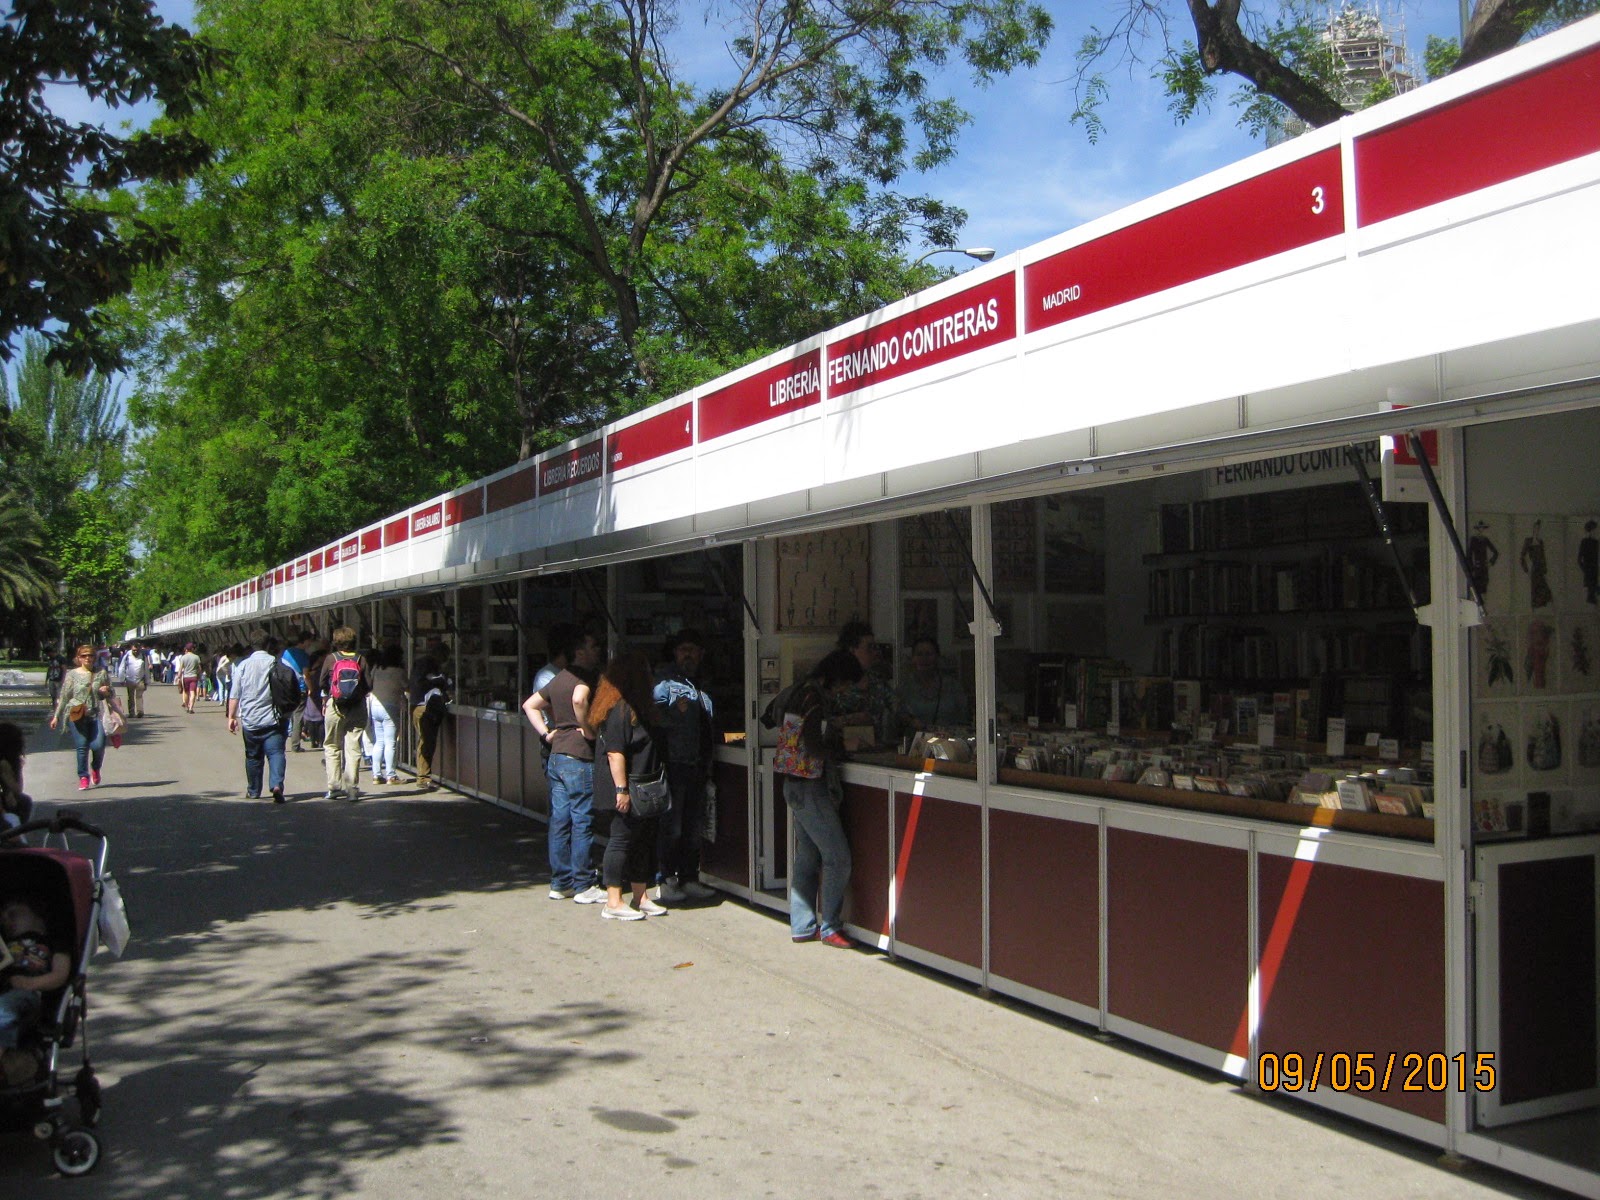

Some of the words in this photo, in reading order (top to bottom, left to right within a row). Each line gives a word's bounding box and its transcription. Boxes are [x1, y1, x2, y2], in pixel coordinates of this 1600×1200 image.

[1311, 186, 1324, 214] 3
[1042, 284, 1081, 311] MADRID
[769, 361, 821, 407] LIBRERÍA
[828, 336, 899, 386] FERNANDO
[902, 298, 999, 360] CONTRERAS
